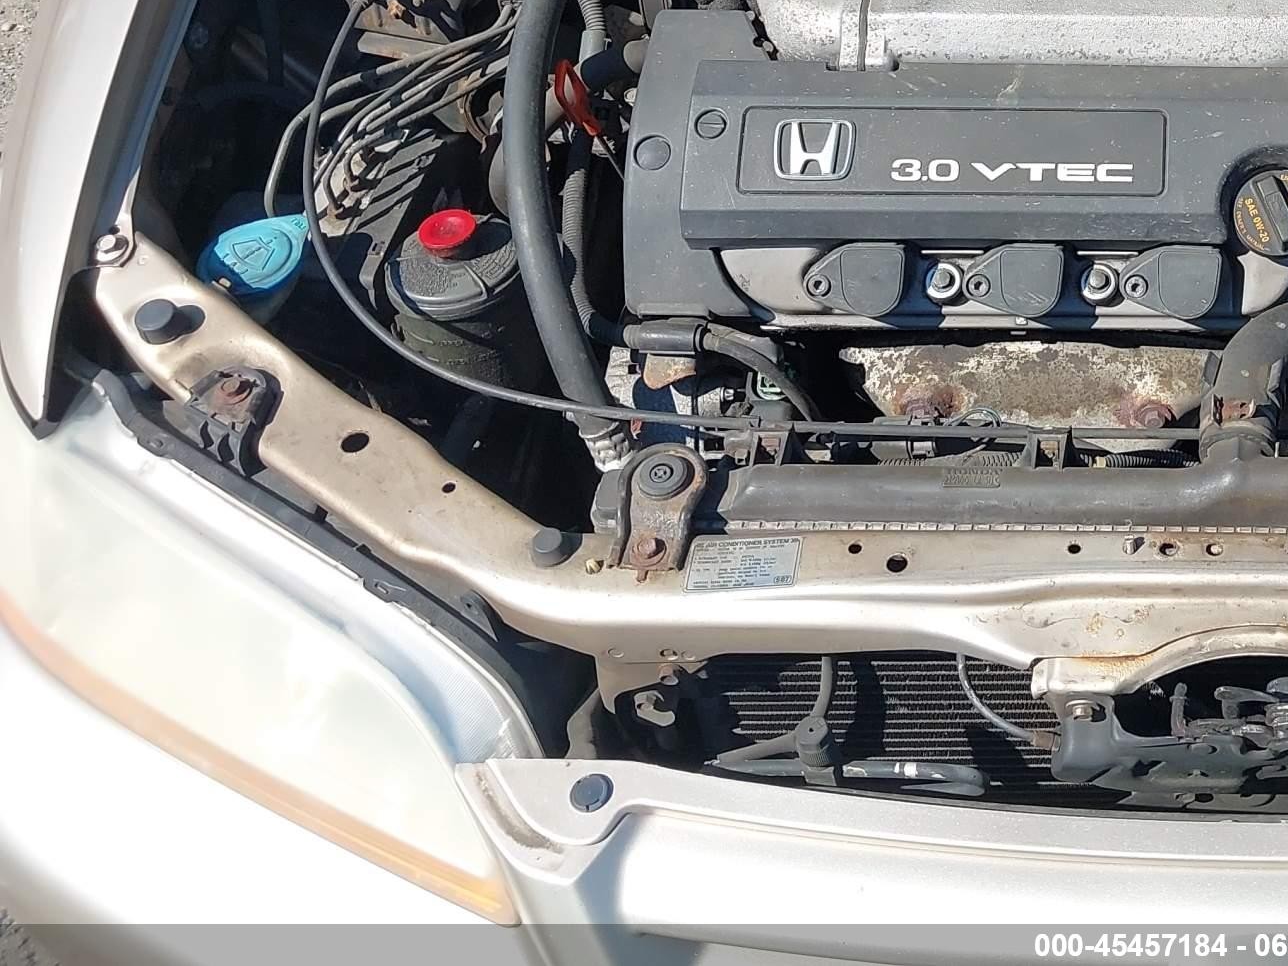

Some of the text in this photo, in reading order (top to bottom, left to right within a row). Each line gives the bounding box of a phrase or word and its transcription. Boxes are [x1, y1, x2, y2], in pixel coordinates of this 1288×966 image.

[890, 158, 1134, 183] 3.0 VTEC
[1244, 198, 1270, 243] SAE 0W-20
[718, 539, 762, 548] CONDITIONER
